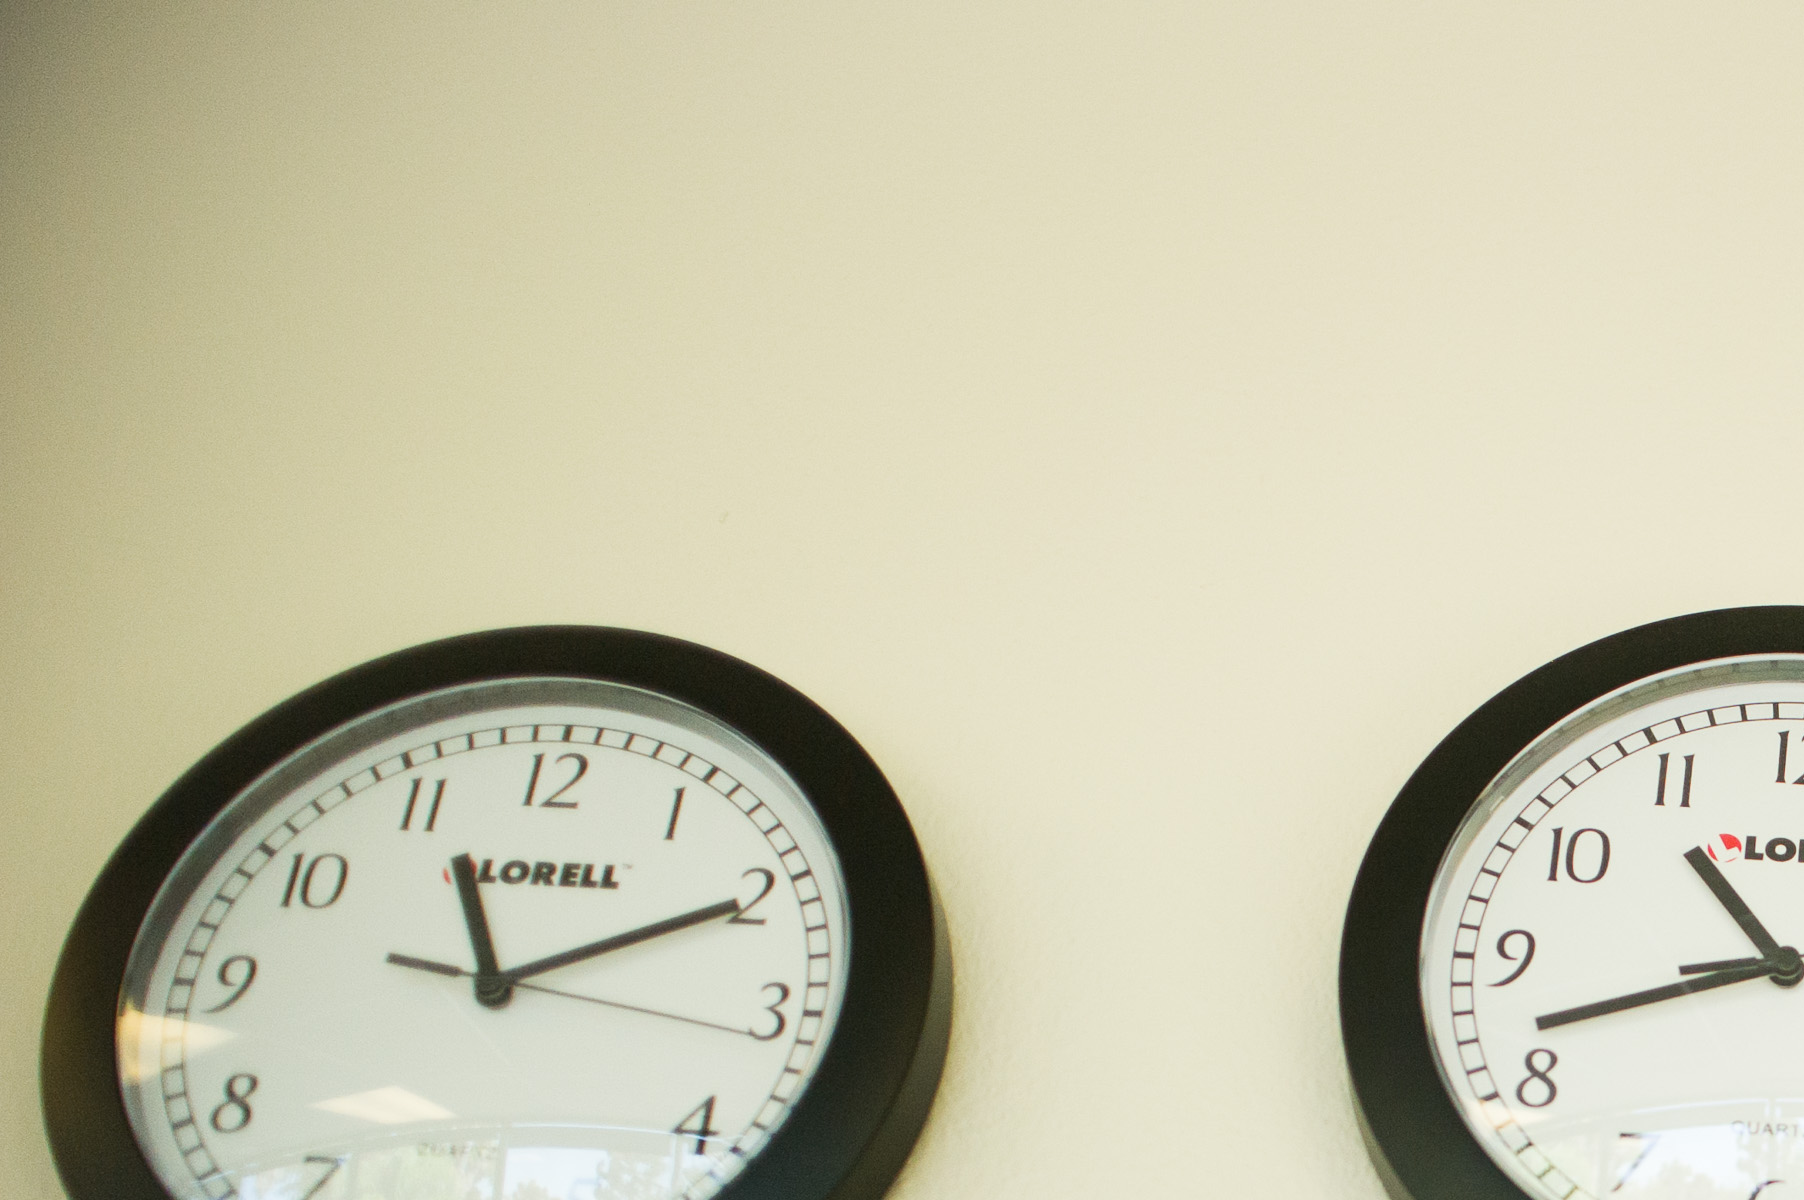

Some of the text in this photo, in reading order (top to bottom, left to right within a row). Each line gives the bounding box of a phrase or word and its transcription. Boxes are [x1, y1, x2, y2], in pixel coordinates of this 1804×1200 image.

[398, 777, 448, 833] 11
[522, 752, 589, 809] 12
[1654, 753, 1696, 807] 11
[662, 786, 688, 841] 1
[280, 852, 348, 909] 10
[475, 858, 620, 890] LORELL
[1547, 828, 1611, 883] 10
[727, 867, 777, 927] 2
[206, 955, 258, 1013] 9
[1488, 929, 1536, 986] 9
[747, 982, 791, 1041] 3
[211, 1073, 259, 1134] 8
[1516, 1049, 1559, 1108] 8
[673, 1095, 719, 1155] 4
[1610, 1132, 1659, 1192] 7
